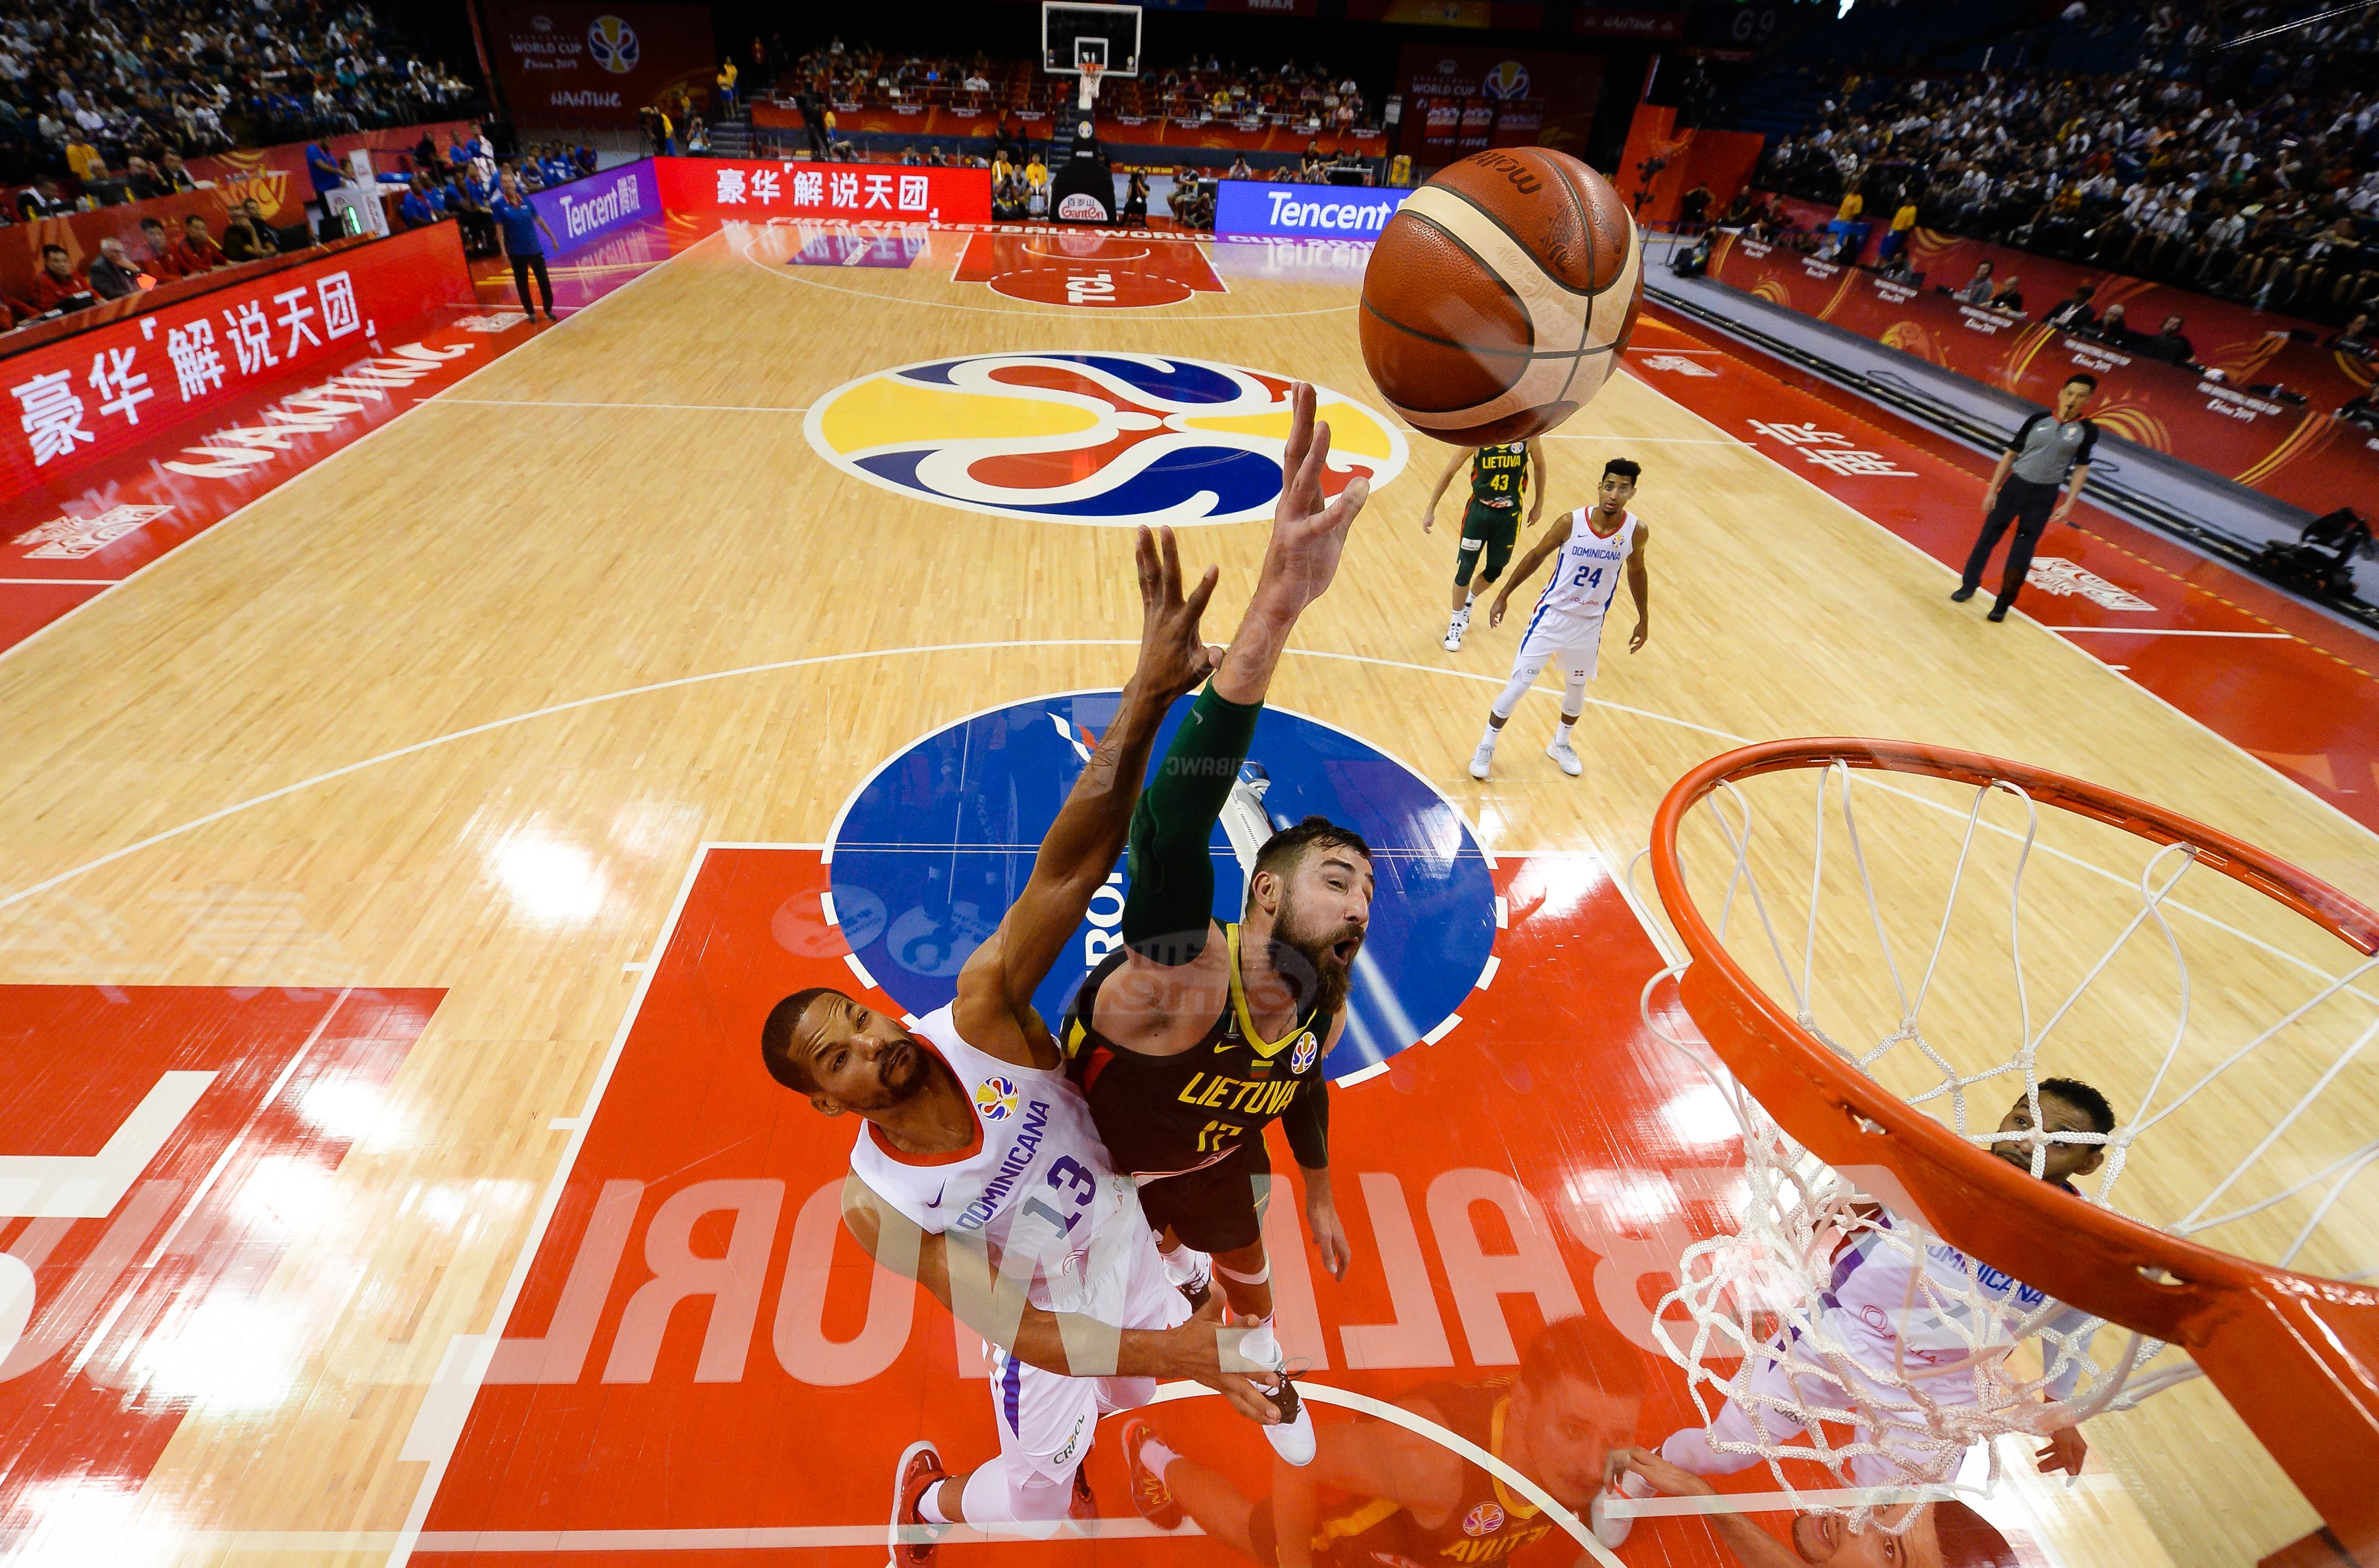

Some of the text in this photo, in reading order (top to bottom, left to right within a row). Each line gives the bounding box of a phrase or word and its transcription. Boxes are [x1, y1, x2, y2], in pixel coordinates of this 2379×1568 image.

[512, 42, 582, 54] WORLD CUP
[1412, 83, 1476, 96] WORLD CUP
[559, 186, 619, 239] Tencent
[1268, 191, 1392, 230] Tencent
[767, 216, 849, 228] FIBA
[859, 220, 1086, 237] BASKETBALL
[1095, 229, 1217, 242] WORLD
[1228, 234, 1295, 246] CUP
[1065, 274, 1115, 304] TCL
[1482, 455, 1521, 469] LIETUVA
[1490, 474, 1509, 491] 43
[1572, 545, 1621, 562] DOMINICANA
[1573, 566, 1604, 589] 24
[1177, 1072, 1299, 1115] LIETUVA
[1197, 1120, 1243, 1152] 17
[956, 1099, 1050, 1231] DOMINICANA
[1022, 1155, 1096, 1241] 13
